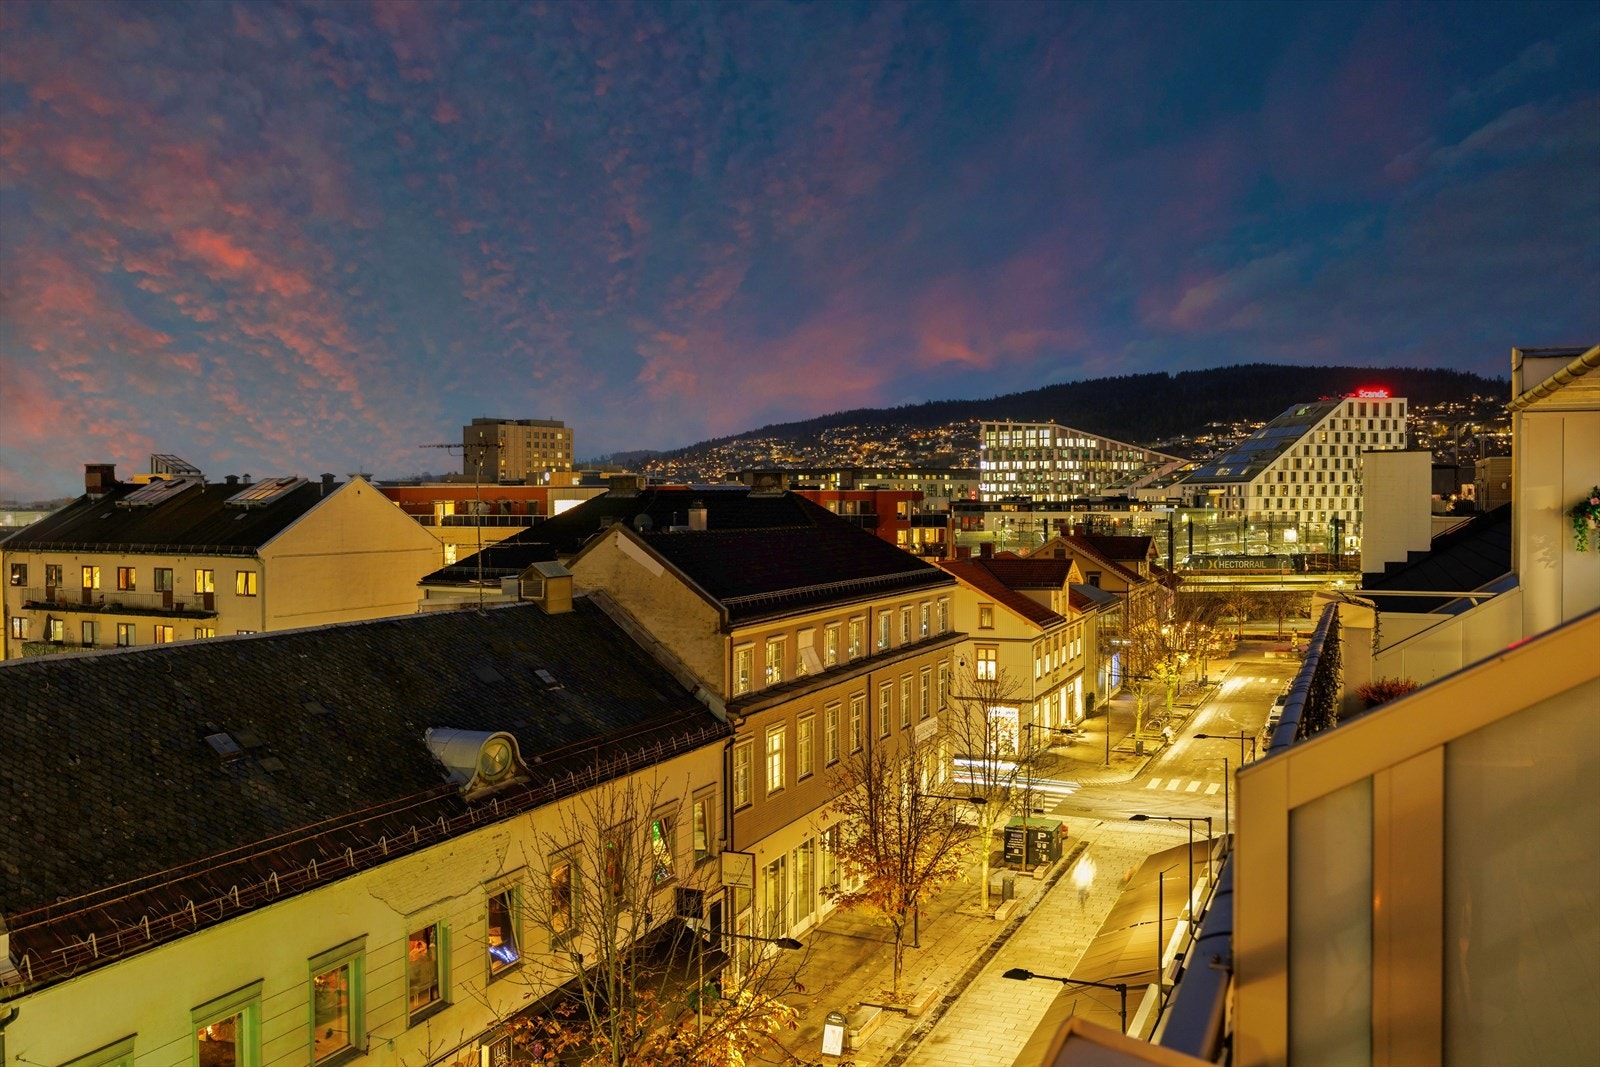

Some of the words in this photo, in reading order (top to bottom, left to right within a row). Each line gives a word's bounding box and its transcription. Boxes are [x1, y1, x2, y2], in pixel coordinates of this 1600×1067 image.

[1359, 389, 1389, 398] Scandic
[1219, 560, 1267, 569] HECTORRAIL
[1037, 832, 1047, 840] P
